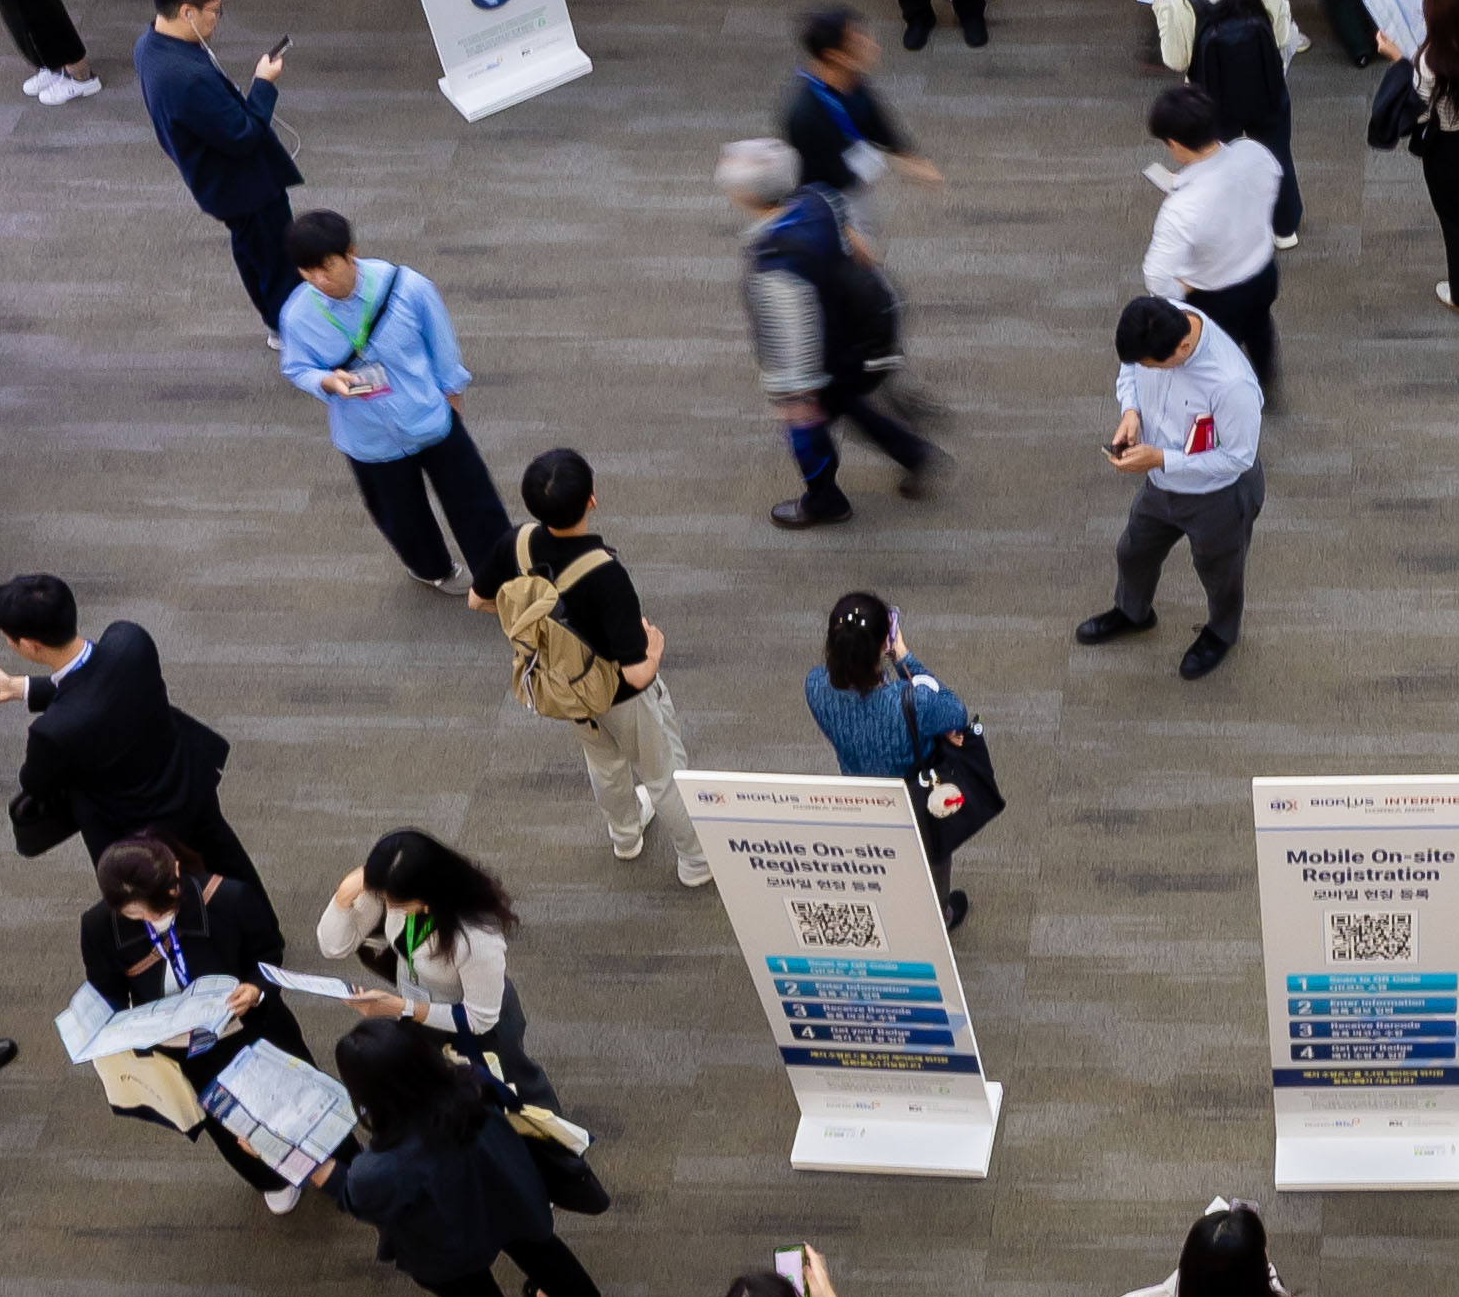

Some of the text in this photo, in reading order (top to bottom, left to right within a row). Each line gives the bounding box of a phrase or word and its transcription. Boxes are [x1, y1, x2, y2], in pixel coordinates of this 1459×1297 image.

[729, 838, 896, 860] Mobile On-site
[1286, 848, 1456, 865] Mobile On-site
[748, 856, 886, 877] Registration
[766, 876, 812, 890] 모바일
[1302, 867, 1440, 886] Registration
[1312, 889, 1359, 901] 모바일
[776, 959, 788, 973] 1
[783, 982, 800, 996] 2
[1297, 978, 1308, 991] 1
[792, 1004, 807, 1018] 3
[1297, 1001, 1312, 1014] 2
[801, 1026, 816, 1040] 4
[1297, 1023, 1312, 1037] 3
[1299, 1046, 1315, 1059] 4
